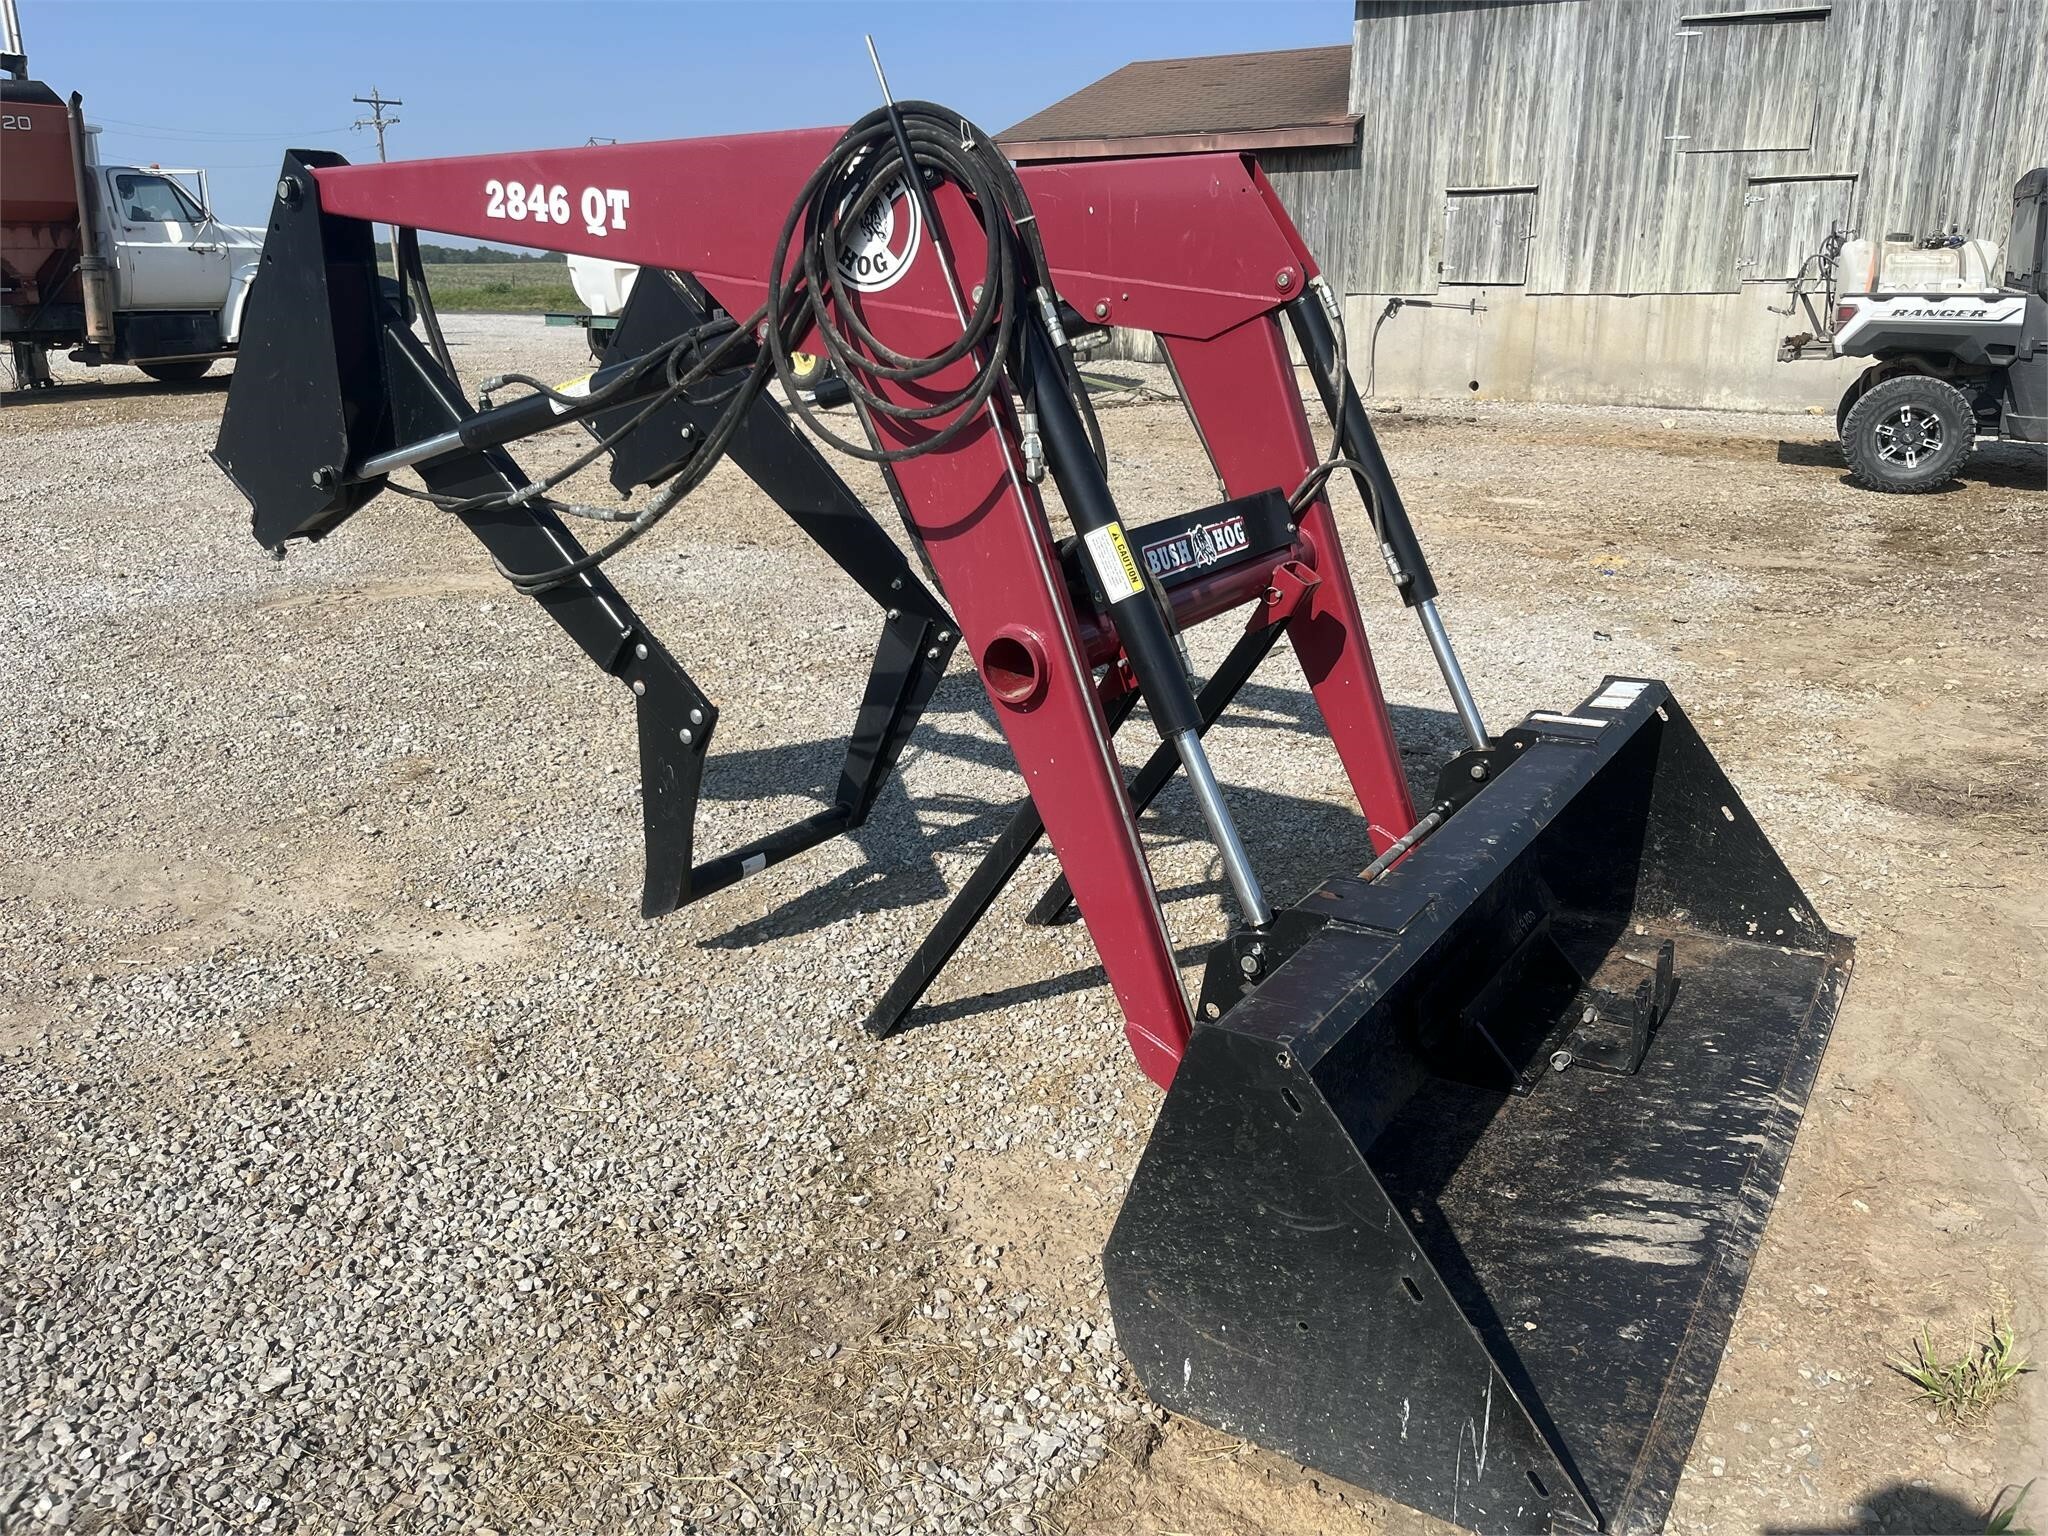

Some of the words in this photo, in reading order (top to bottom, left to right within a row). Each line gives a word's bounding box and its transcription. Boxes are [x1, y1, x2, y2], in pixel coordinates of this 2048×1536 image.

[485, 180, 570, 225] 2846
[581, 186, 630, 236] QT
[1891, 308, 1988, 317] RANGER
[1117, 543, 1139, 583] CAUTION
[1146, 539, 1193, 574] BUSH
[1211, 522, 1246, 552] HOG
